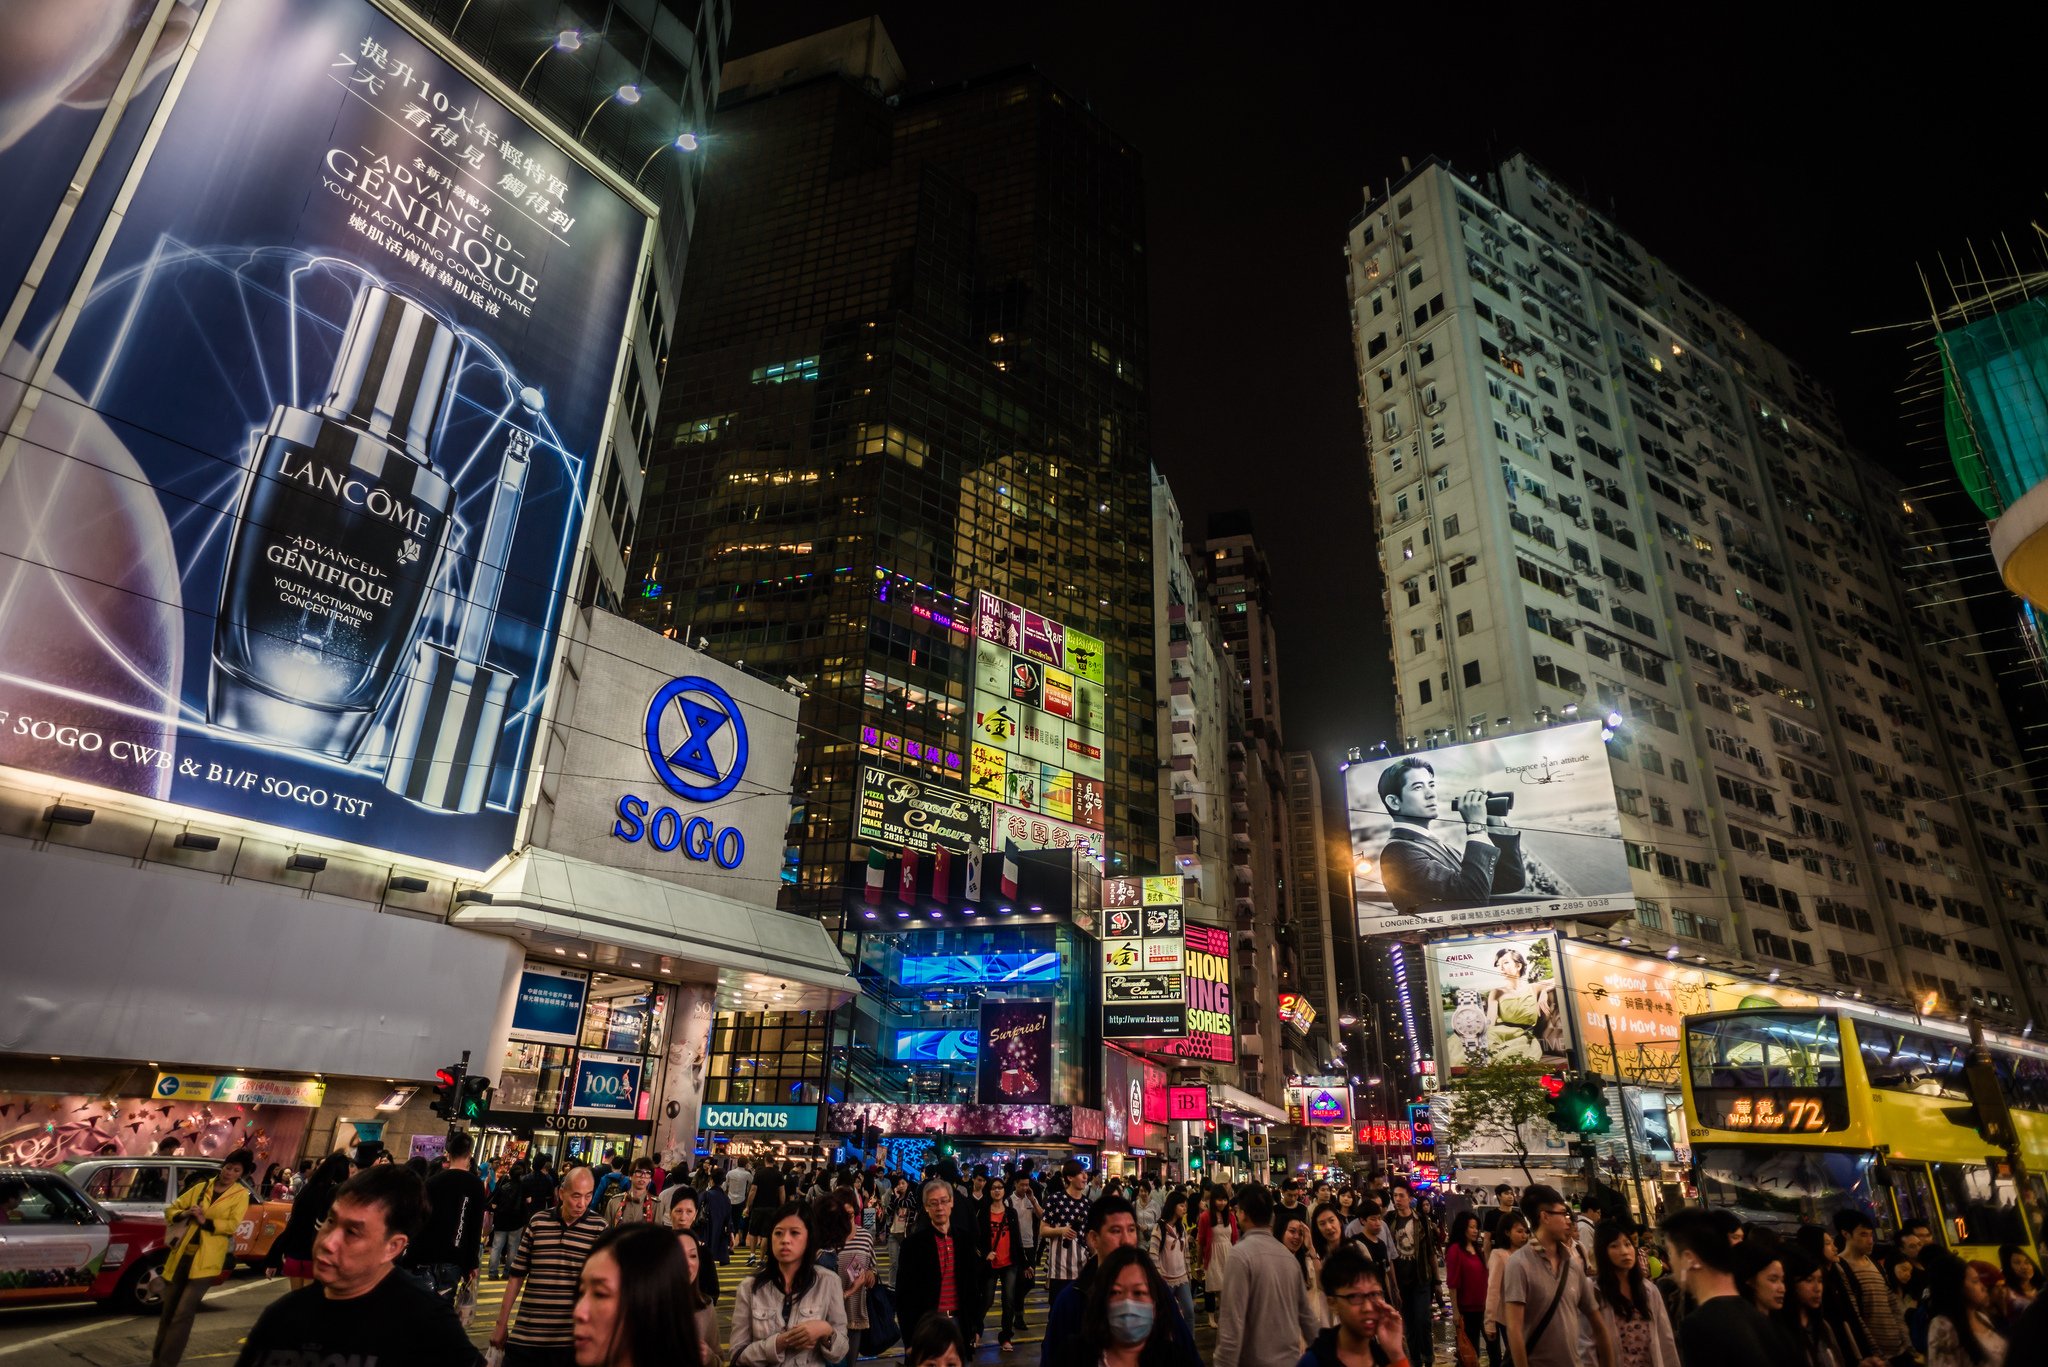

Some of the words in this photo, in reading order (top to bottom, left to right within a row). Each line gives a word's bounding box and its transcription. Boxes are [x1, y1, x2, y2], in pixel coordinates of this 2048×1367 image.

[360, 36, 569, 204] 提升10大年輕特質
[331, 52, 386, 96] 7天
[401, 101, 486, 170] 看得見
[497, 172, 577, 233] 觸得到
[412, 156, 493, 217] 全新升級配方
[326, 148, 539, 304] GÉNIFIQUE
[320, 175, 371, 214] YOUTH
[371, 209, 445, 262] ACTIVATING
[446, 257, 533, 318] CONCENTRATE
[278, 452, 431, 538] LANCÔME
[266, 545, 394, 608] GÉNIFIQUE
[274, 577, 312, 598] YOUTH
[312, 591, 373, 622] ACTIVATING
[279, 592, 362, 629] CONCENTRATE
[981, 594, 1004, 618] THAI
[1004, 608, 1021, 623] Perfect
[933, 612, 951, 625] THAI
[981, 614, 1019, 649] 泰式食
[1053, 632, 1063, 645] 8/F
[13, 714, 104, 753] SOGO
[108, 740, 173, 770] CWB
[179, 757, 202, 778] &
[206, 762, 259, 791] B1/F
[261, 777, 329, 808] SOGO
[333, 793, 374, 818] TST
[1505, 763, 1538, 775] Elegance
[1561, 754, 1590, 765] attitude
[864, 798, 884, 810] PASTA
[865, 790, 885, 801] PIZZA
[866, 769, 886, 787] 4/F
[887, 777, 969, 822] Pancake
[862, 817, 883, 829] SNACK
[863, 808, 884, 819] PARTY
[904, 809, 972, 843] Colours
[612, 794, 745, 870] SOGO
[885, 823, 903, 834] CAFE
[912, 830, 929, 841] BAR
[1563, 901, 1584, 911] 2895
[1587, 899, 1610, 909] 0938
[1446, 954, 1474, 963] ENICAR
[1187, 977, 1230, 1014] ING
[989, 1016, 1047, 1044] Surprise!
[1109, 1015, 1179, 1025] http://www.izzue.com
[545, 1116, 588, 1131] SOGO
[706, 1107, 788, 1128] bauhaus
[1730, 1113, 1752, 1124] Wah
[1757, 1113, 1784, 1124] Kwai
[1789, 1102, 1824, 1125] 72
[1691, 1129, 1710, 1138] 8319
[1416, 1151, 1436, 1162] Nik
